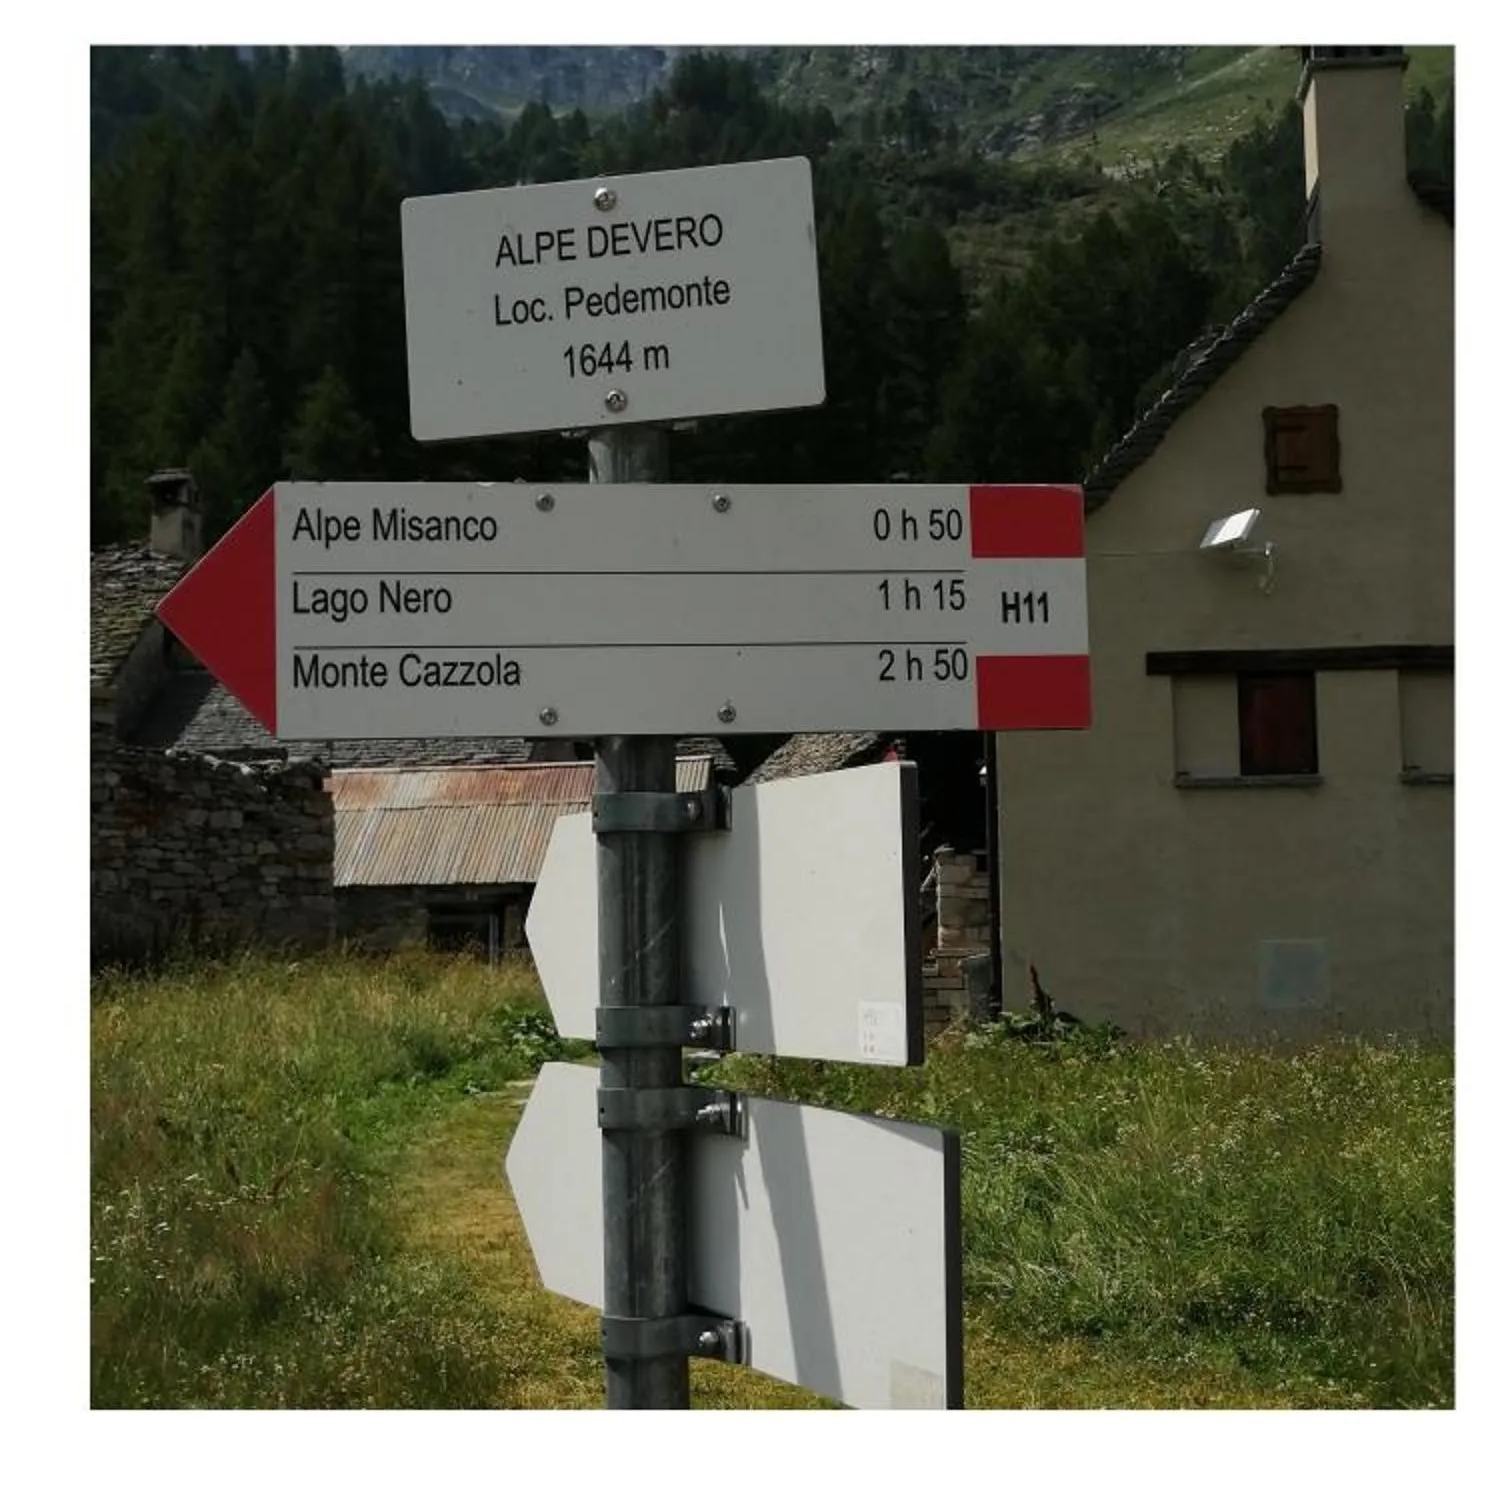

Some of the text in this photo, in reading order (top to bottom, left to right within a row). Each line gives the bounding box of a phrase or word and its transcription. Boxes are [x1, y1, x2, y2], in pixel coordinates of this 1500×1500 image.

[495, 213, 723, 268] ALPE DEVERO
[494, 275, 731, 326] Loc. Pedemonte
[563, 339, 669, 378] 1644 m
[292, 507, 963, 549] Alpe Misanco 0 h 50
[293, 579, 966, 623] Lago Nero 1 h 15
[1001, 591, 1049, 624] H11
[293, 647, 968, 689] Monte Cazzola 2 h 50
